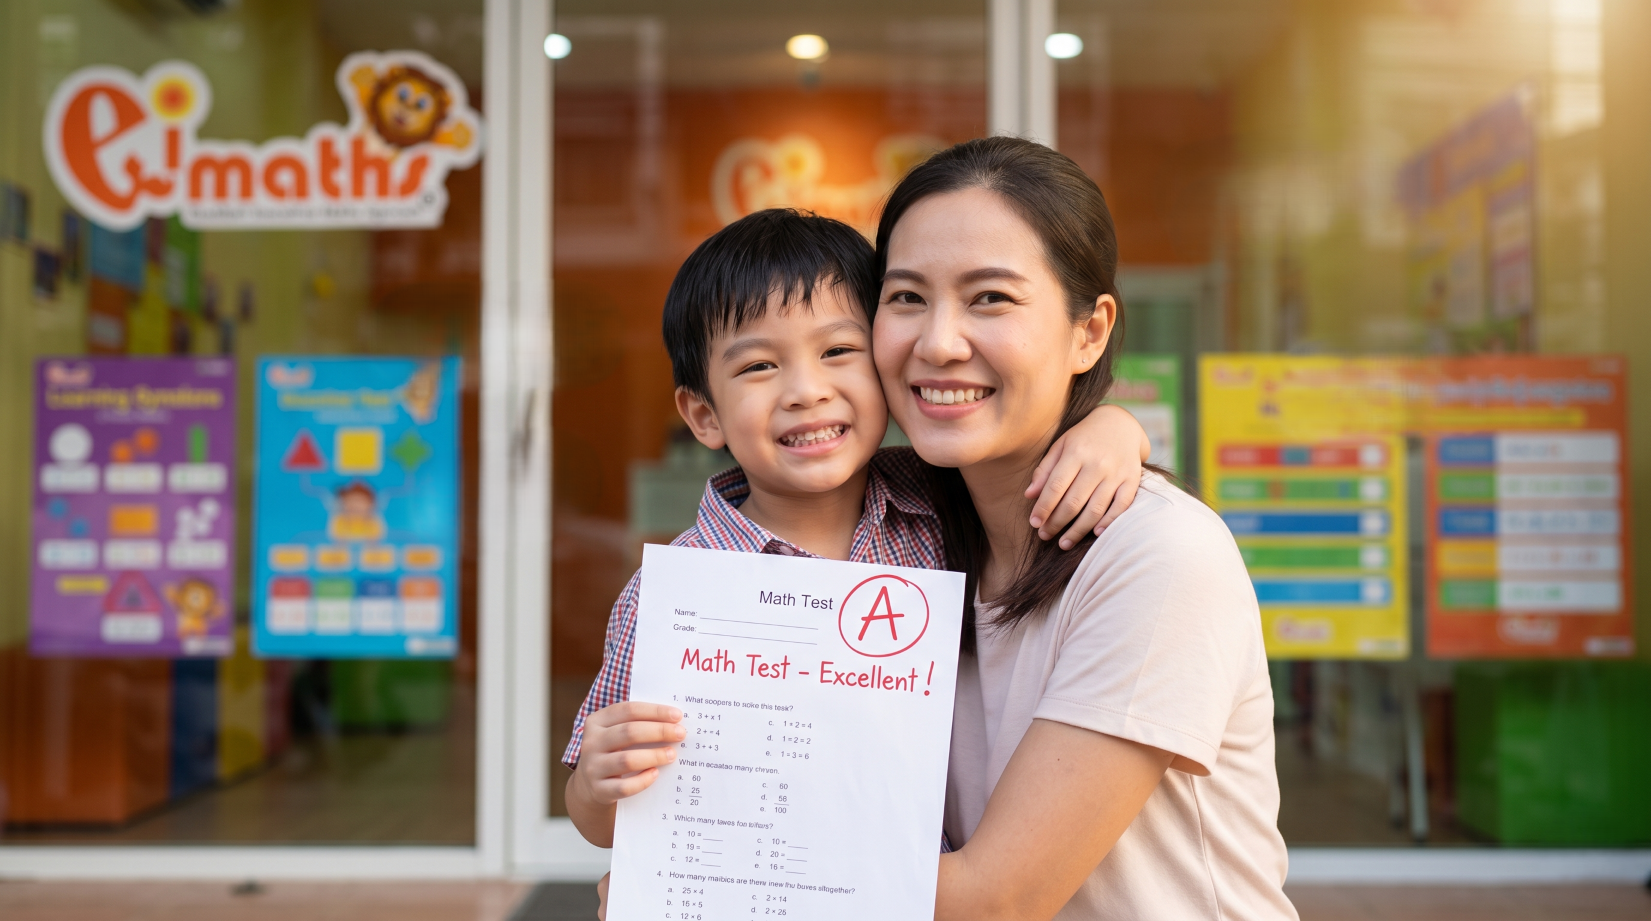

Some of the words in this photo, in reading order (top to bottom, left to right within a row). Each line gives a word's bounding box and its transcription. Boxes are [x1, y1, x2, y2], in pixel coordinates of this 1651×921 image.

[760, 591, 796, 606] Math
[802, 594, 834, 610] Test
[674, 608, 698, 618] Name:
[858, 585, 904, 641] A
[673, 624, 697, 632] Grade:
[680, 648, 735, 674] Math
[746, 654, 790, 680] Test
[820, 661, 918, 692] Excellent
[685, 696, 704, 704] What
[679, 758, 698, 766] What
[686, 874, 706, 882] many
